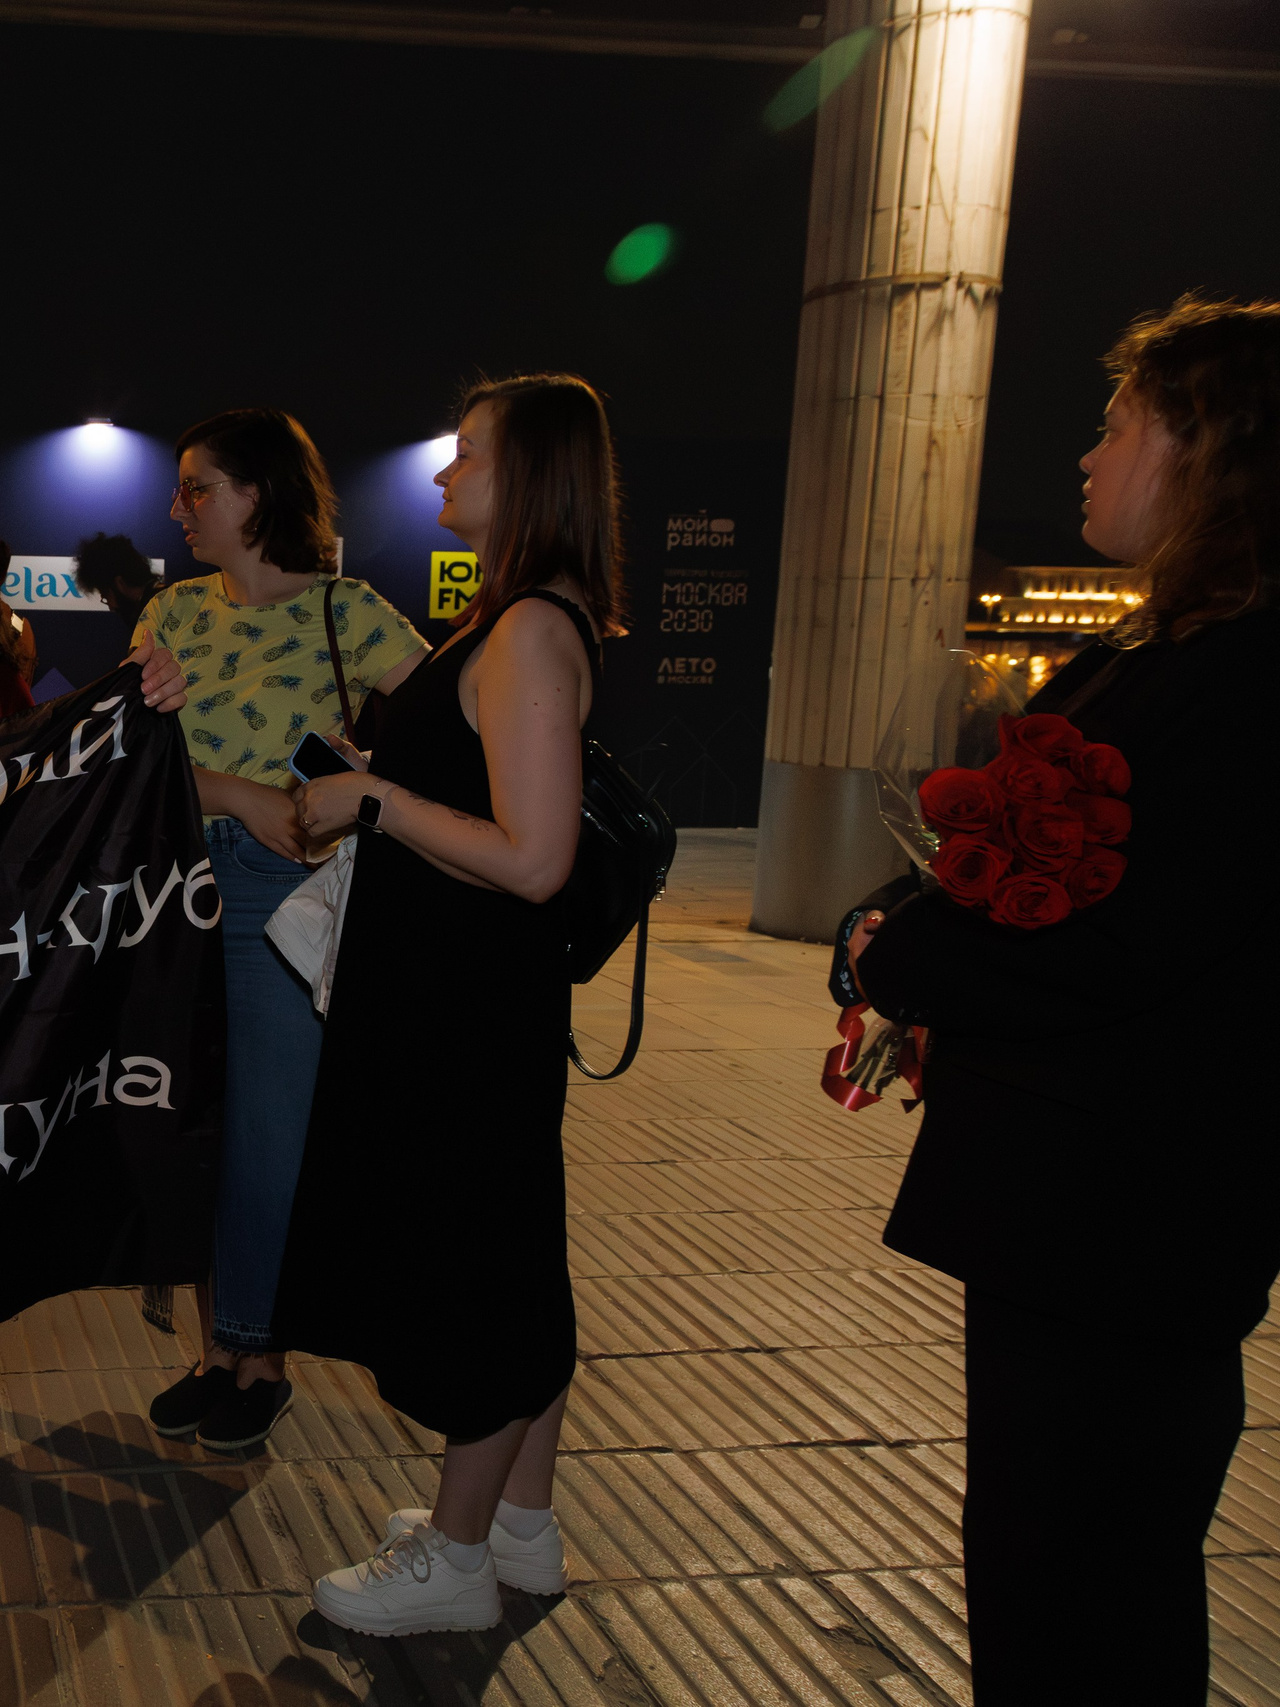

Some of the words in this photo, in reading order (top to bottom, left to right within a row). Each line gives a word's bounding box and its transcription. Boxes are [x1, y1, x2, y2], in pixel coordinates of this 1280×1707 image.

[0, 566, 84, 603] elax
[661, 582, 748, 606] МОСКВА
[660, 609, 714, 632] 2030
[658, 657, 717, 674] ЛЕТО
